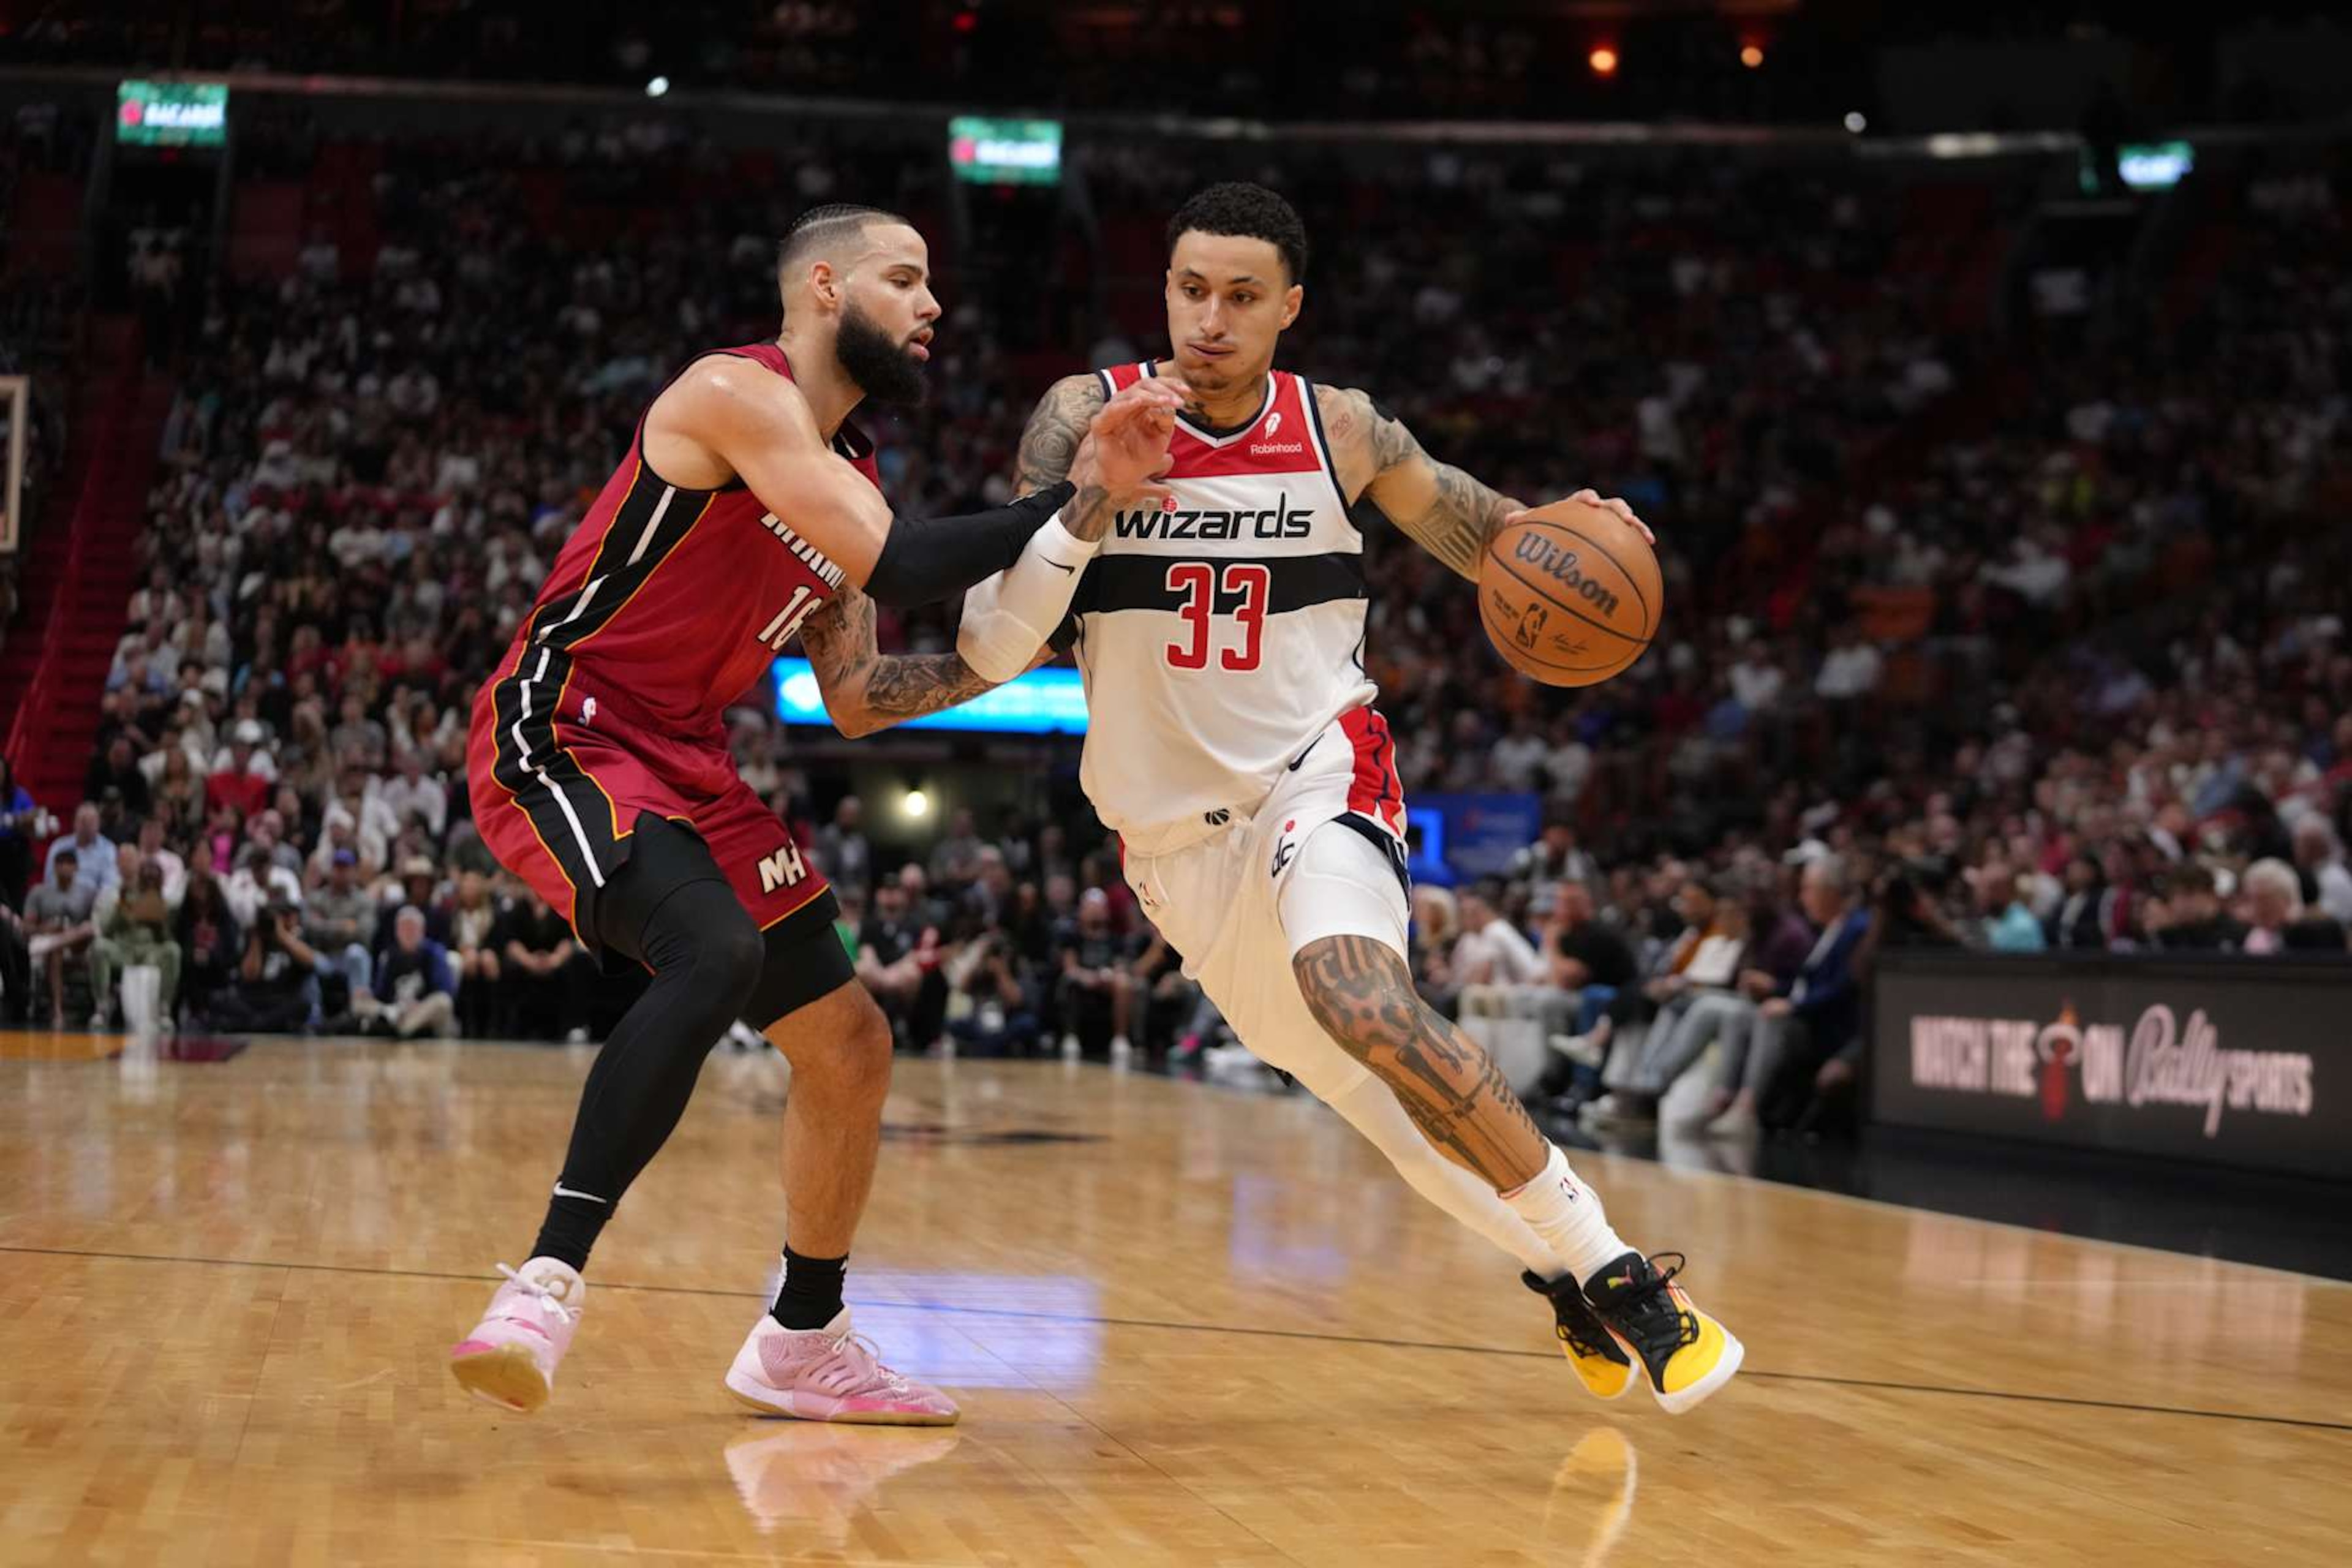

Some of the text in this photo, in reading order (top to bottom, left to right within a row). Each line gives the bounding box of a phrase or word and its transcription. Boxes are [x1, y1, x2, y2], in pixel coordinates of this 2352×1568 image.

[1251, 442, 1303, 456] Robinhood
[1166, 562, 1272, 673] 33
[1516, 532, 1619, 616] Wilson
[1910, 1003, 2313, 1139] WATCH THE ON Bally SPORTS
